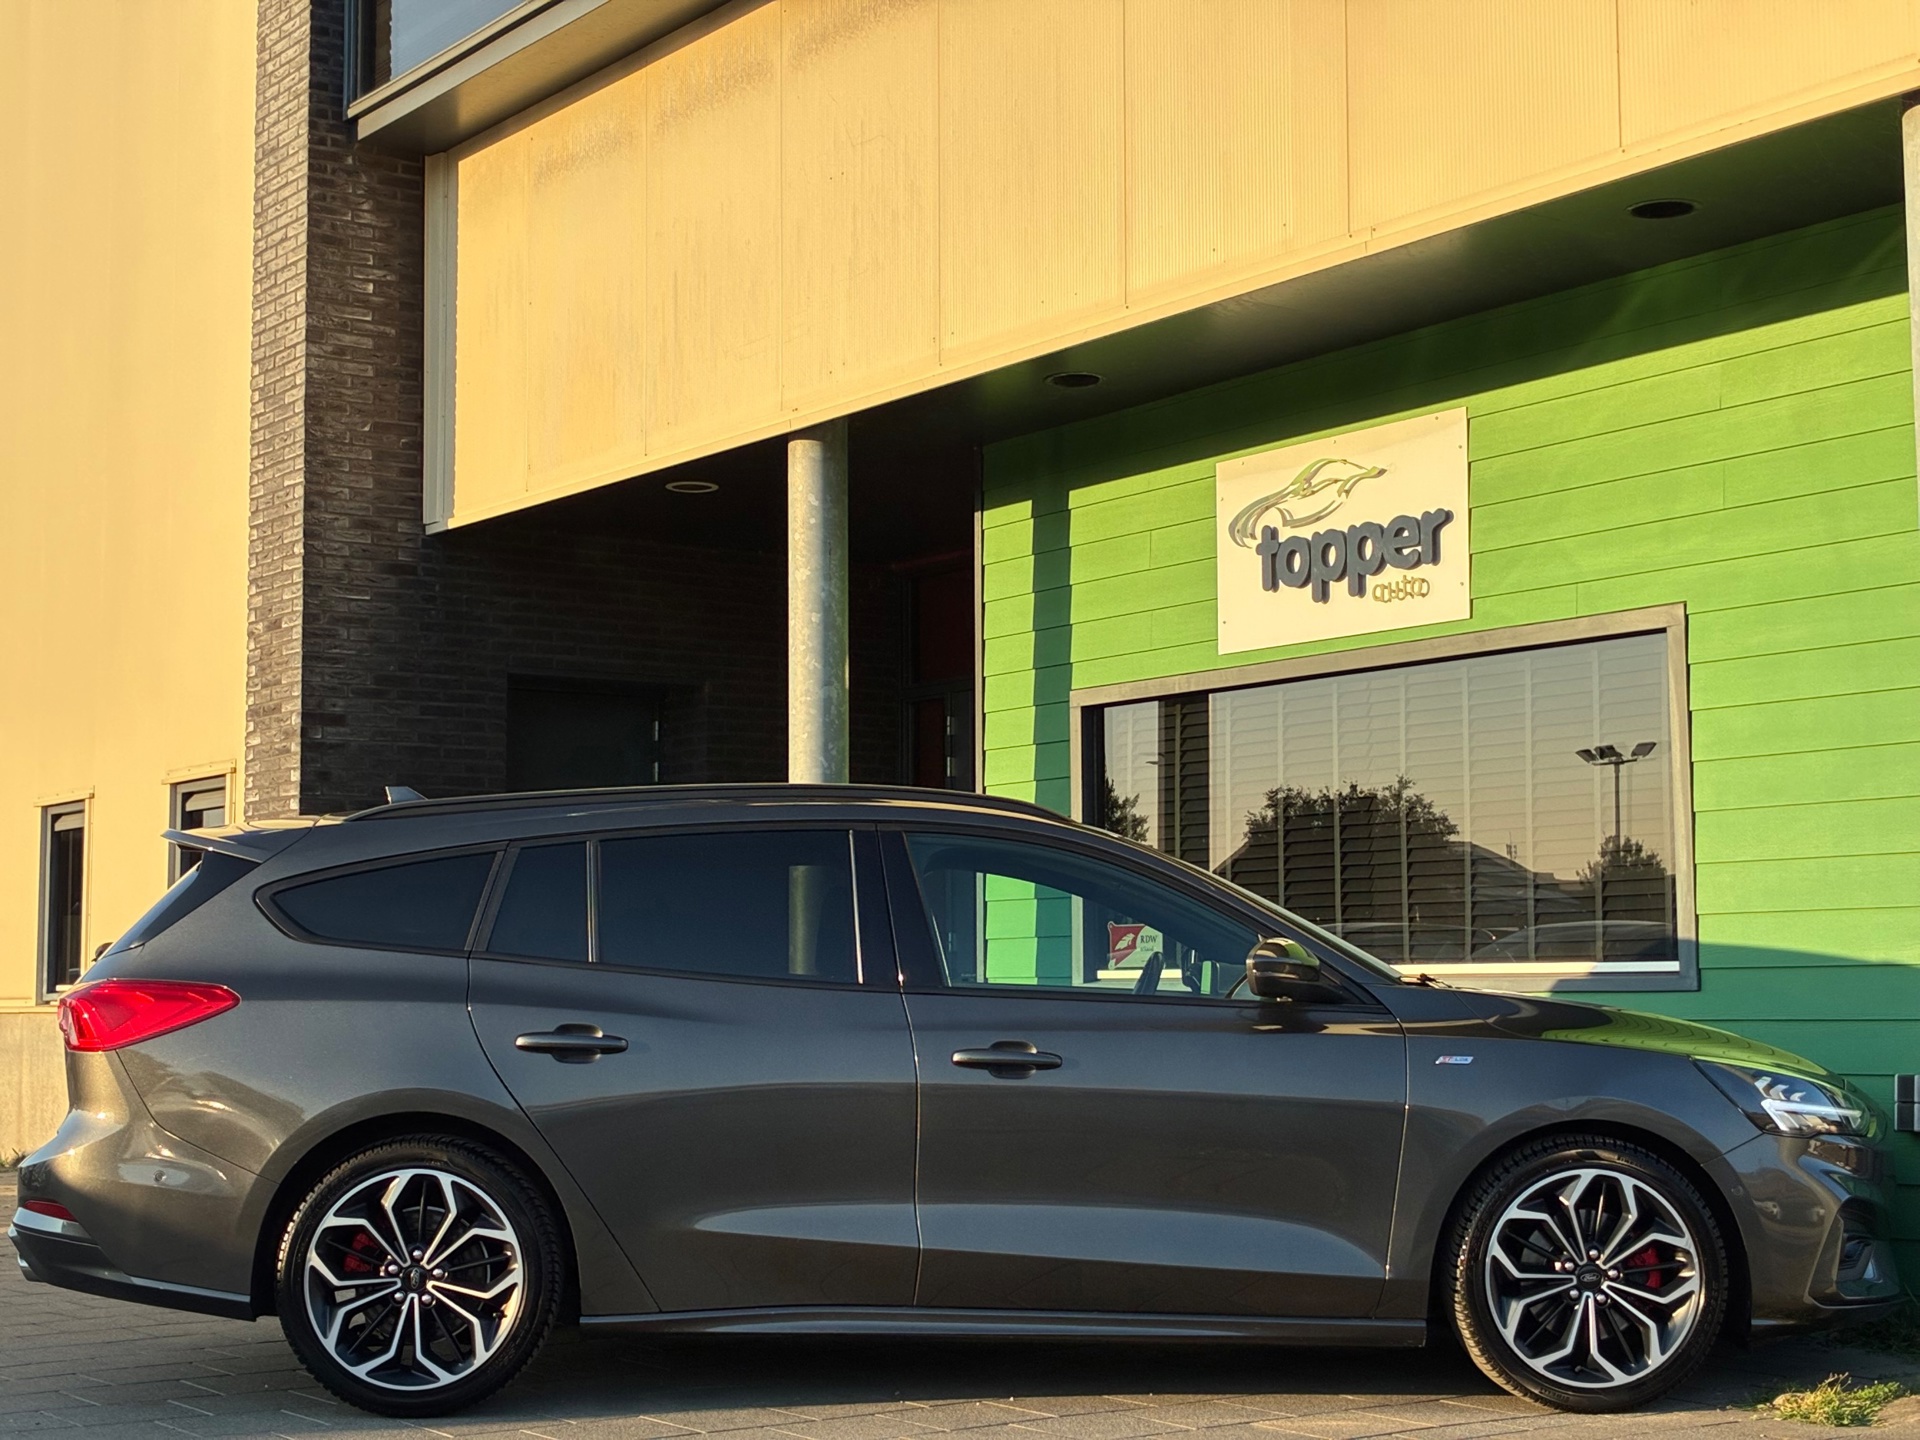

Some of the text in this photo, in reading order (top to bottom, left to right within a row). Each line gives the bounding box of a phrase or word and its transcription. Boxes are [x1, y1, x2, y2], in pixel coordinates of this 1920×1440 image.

[1256, 508, 1453, 604] topper
[1372, 575, 1430, 603] auto
[1140, 935, 1158, 943] RDW
